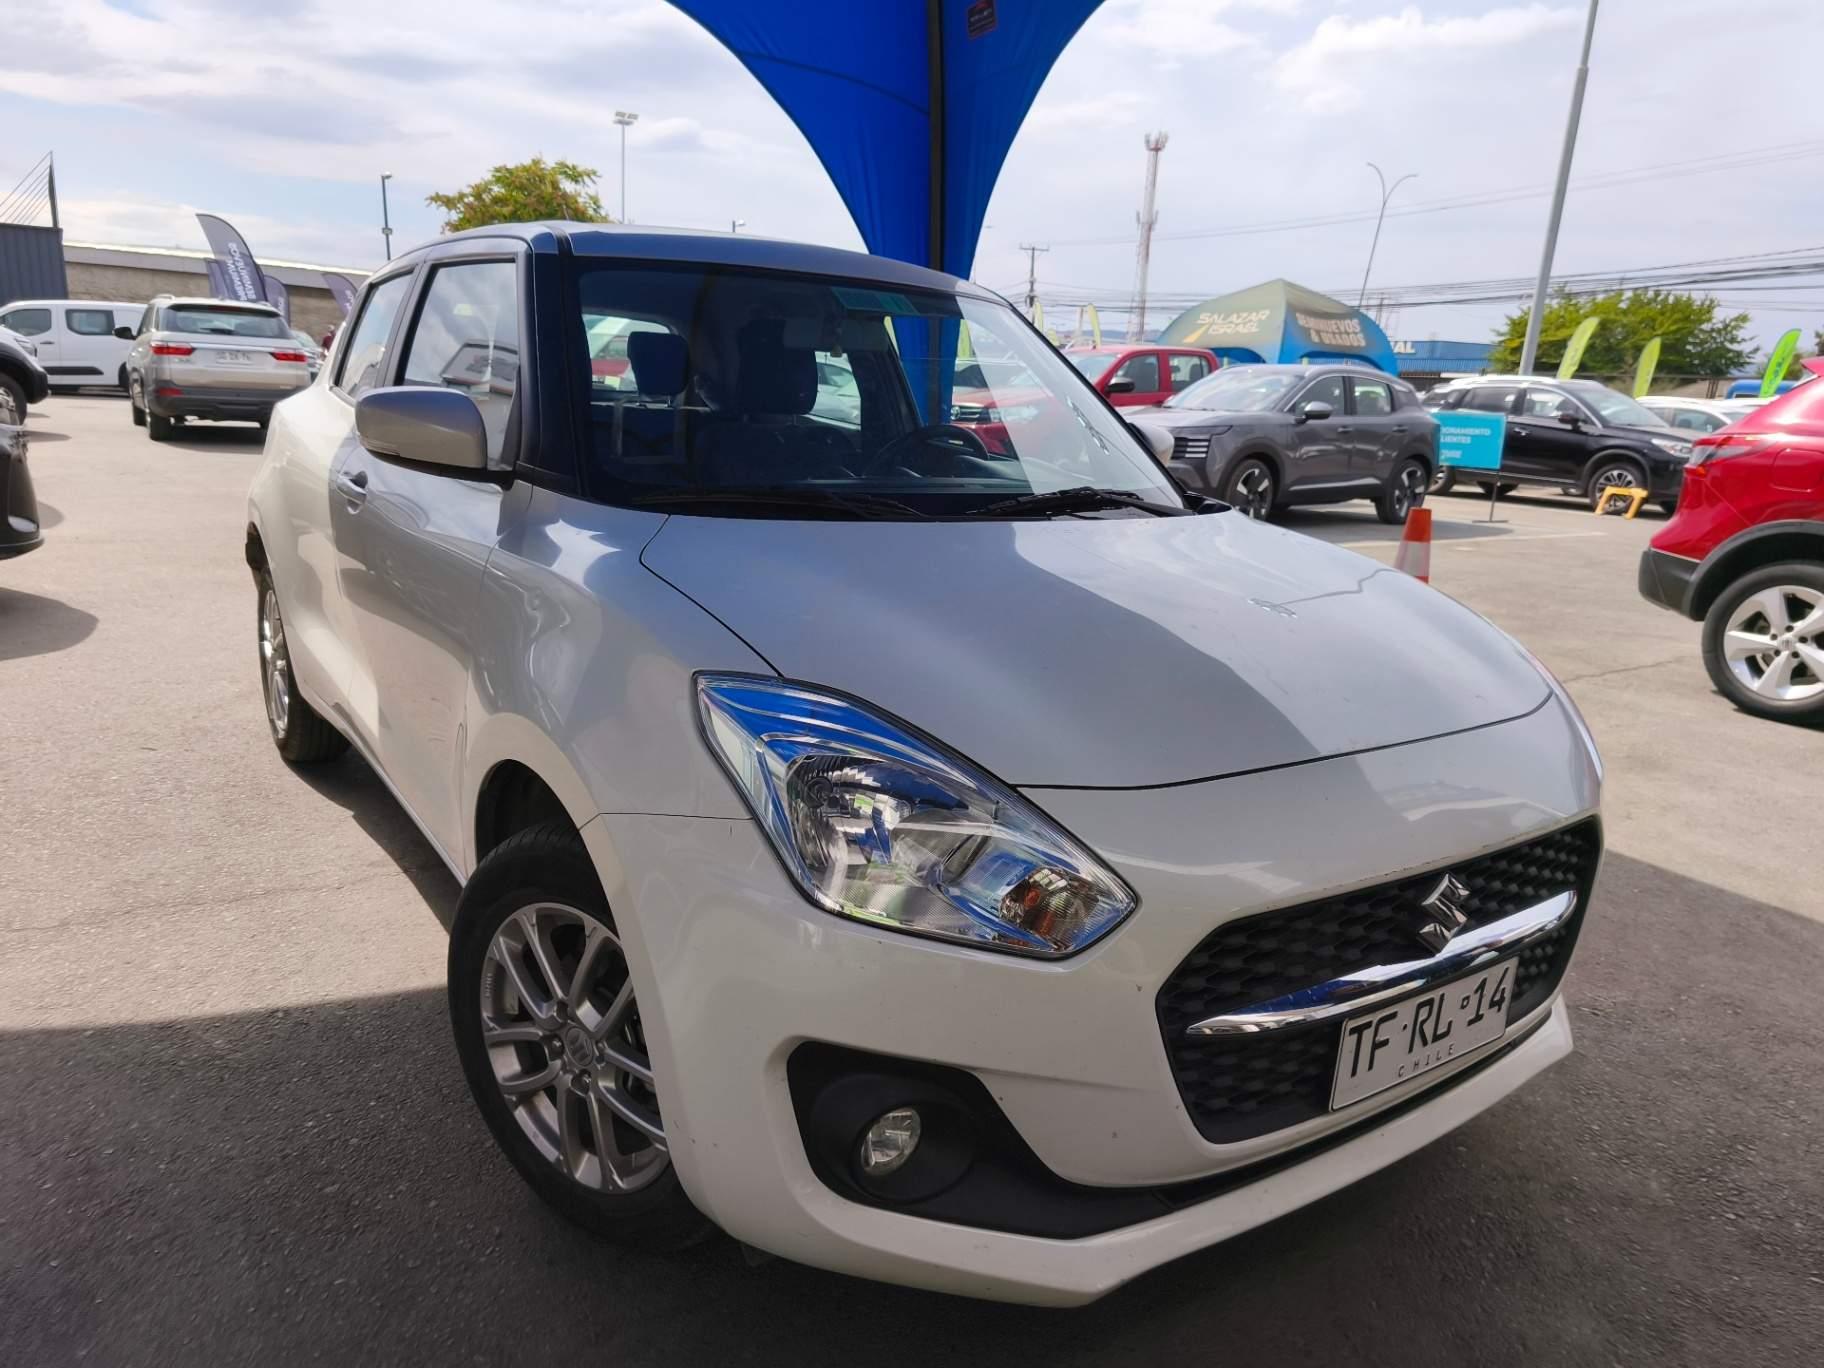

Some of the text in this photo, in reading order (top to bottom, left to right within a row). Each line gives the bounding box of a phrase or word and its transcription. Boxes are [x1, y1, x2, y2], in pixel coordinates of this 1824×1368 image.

[1194, 309, 1272, 325] SALAZAR
[1208, 321, 1261, 335] ISRAEL
[1319, 331, 1366, 347] USADOS
[1397, 1043, 1455, 1078] CHILE
